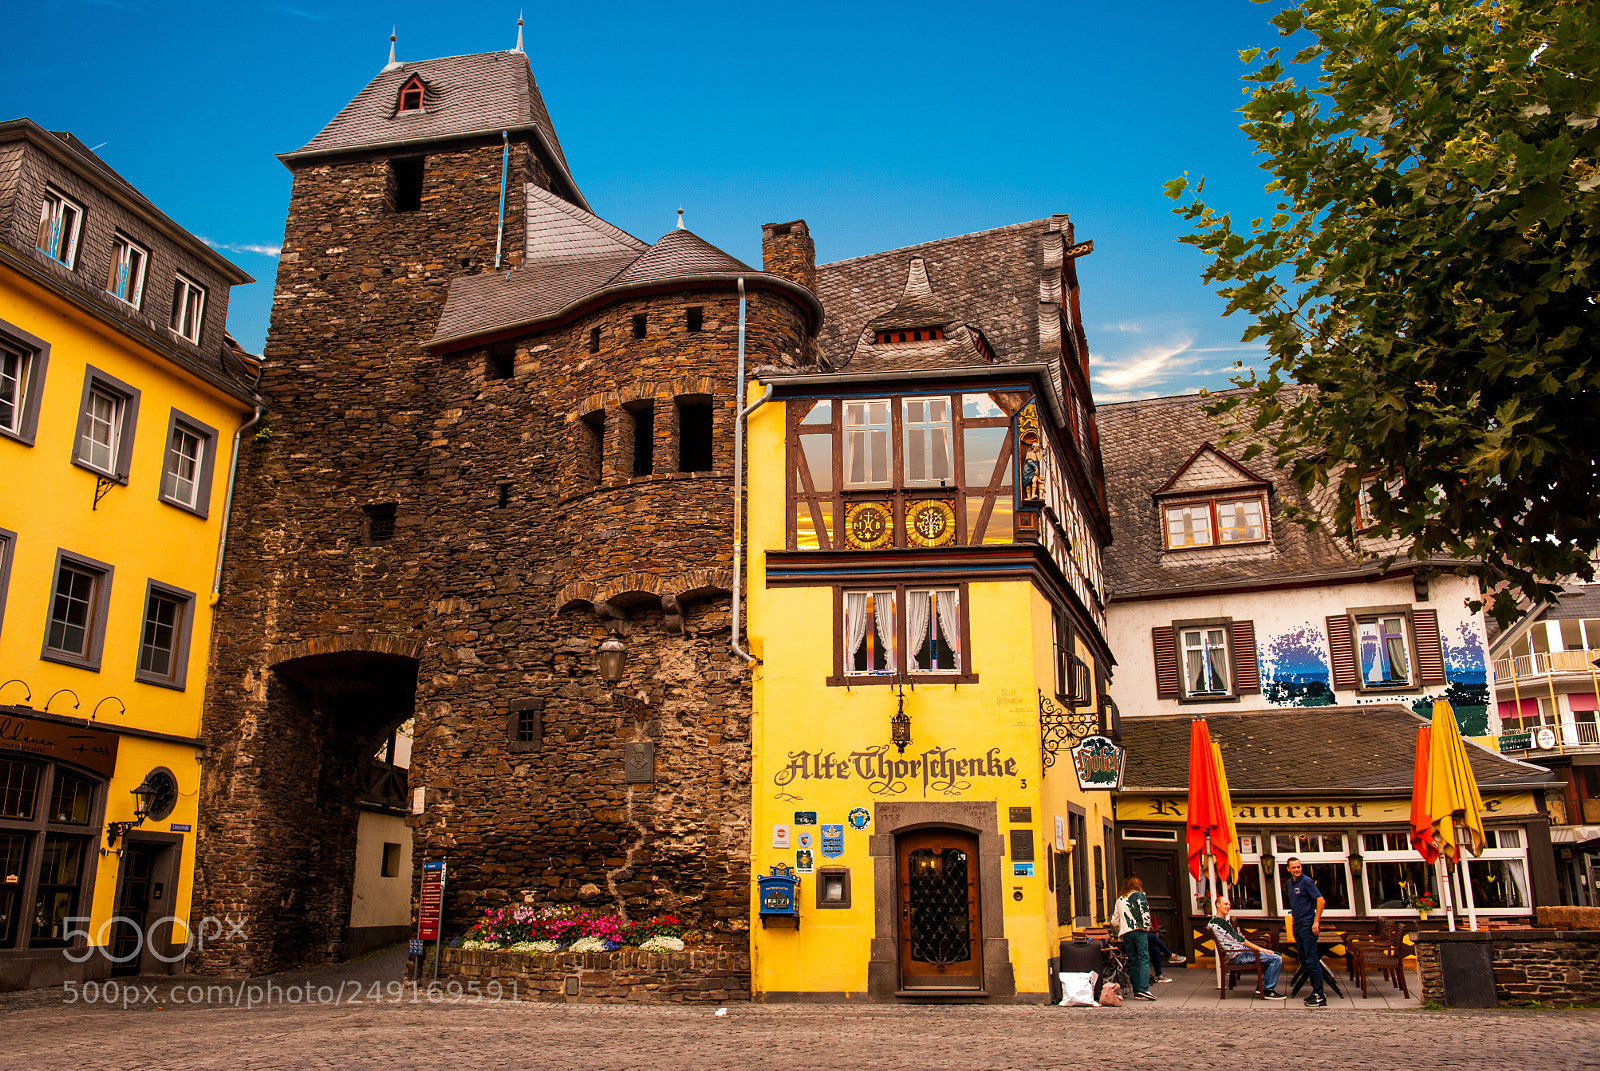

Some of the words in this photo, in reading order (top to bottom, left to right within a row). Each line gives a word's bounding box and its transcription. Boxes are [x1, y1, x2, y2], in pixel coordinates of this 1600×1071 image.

[774, 749, 850, 801] Alte
[1075, 746, 1120, 780] Hotel
[1020, 778, 1028, 790] 3
